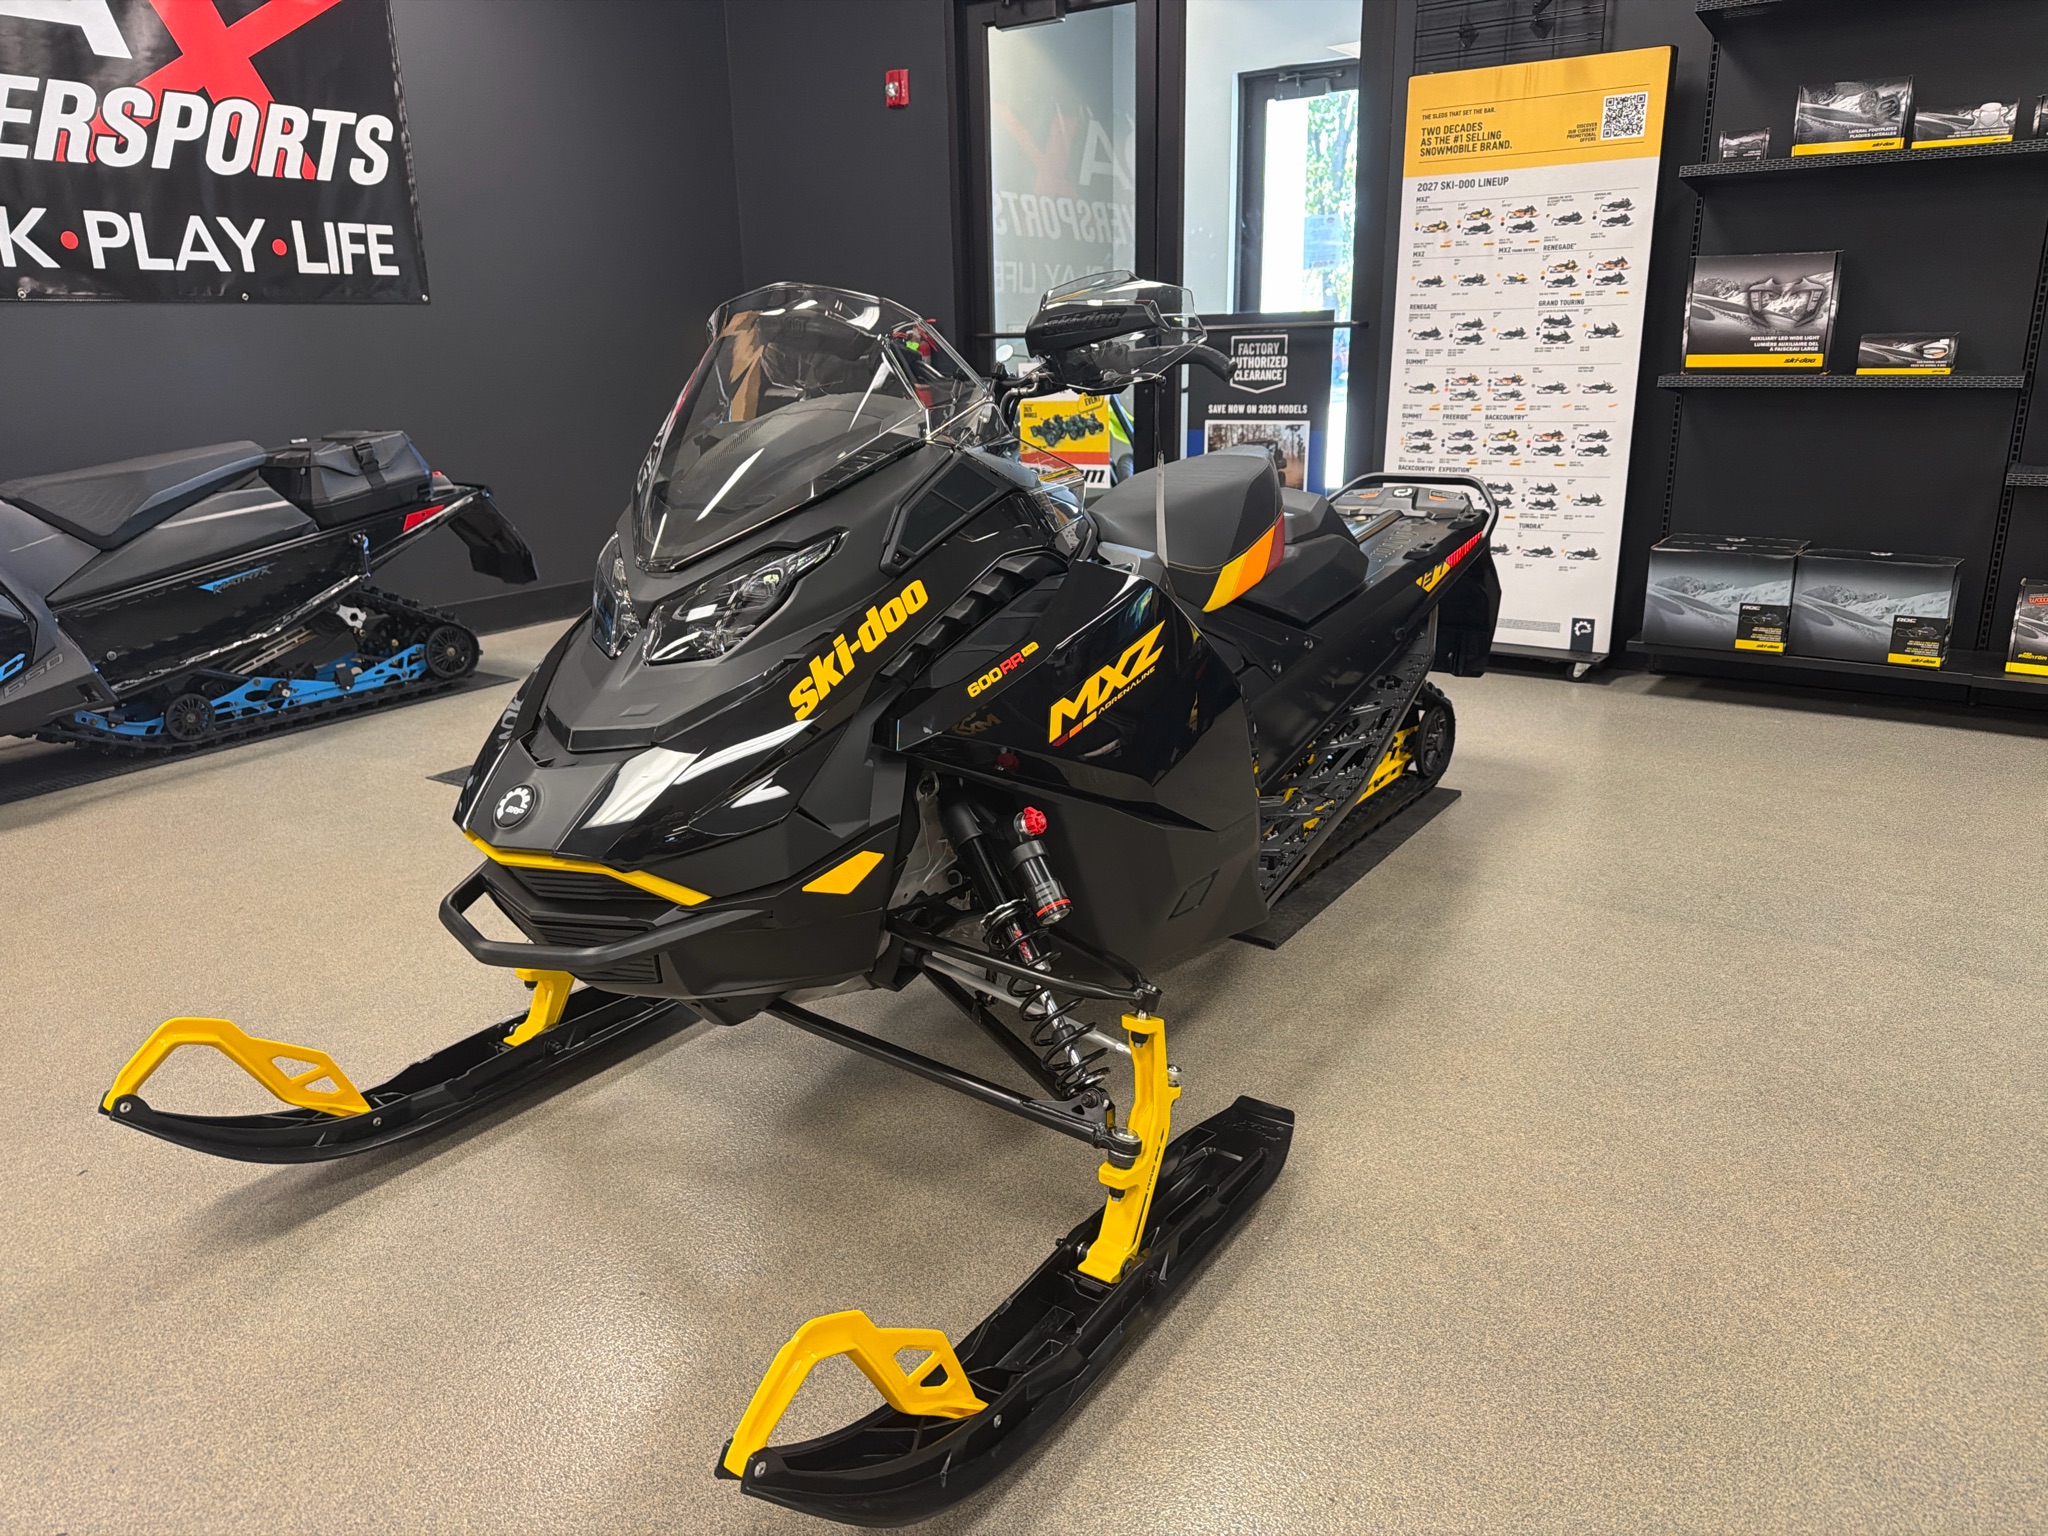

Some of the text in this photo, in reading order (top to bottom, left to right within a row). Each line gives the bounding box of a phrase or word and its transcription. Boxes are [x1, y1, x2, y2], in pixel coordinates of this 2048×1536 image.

[1421, 122, 1483, 136] TWO DECADES
[1420, 130, 1502, 147] AS THE #1 SELLING
[1420, 139, 1513, 157] SNOWMOBILE BRAND.
[1417, 176, 1510, 192] 2027 SKI-DOO LINEUP
[1560, 298, 1585, 306] TOURING
[1238, 342, 1280, 356] FACTORY
[1233, 369, 1283, 381] CLEARANCE
[1208, 404, 1226, 414] SAVE
[1228, 404, 1246, 414] NOW
[1246, 404, 1257, 414] ON
[1278, 404, 1308, 414] MODELS
[1398, 464, 1435, 472] BACKCOUNTRY
[213, 563, 274, 594] MATRIX
[789, 579, 929, 722] ski-doo
[1049, 619, 1166, 744] MXZ
[1098, 665, 1156, 715] ADRENALINE
[505, 805, 525, 815] BRP
